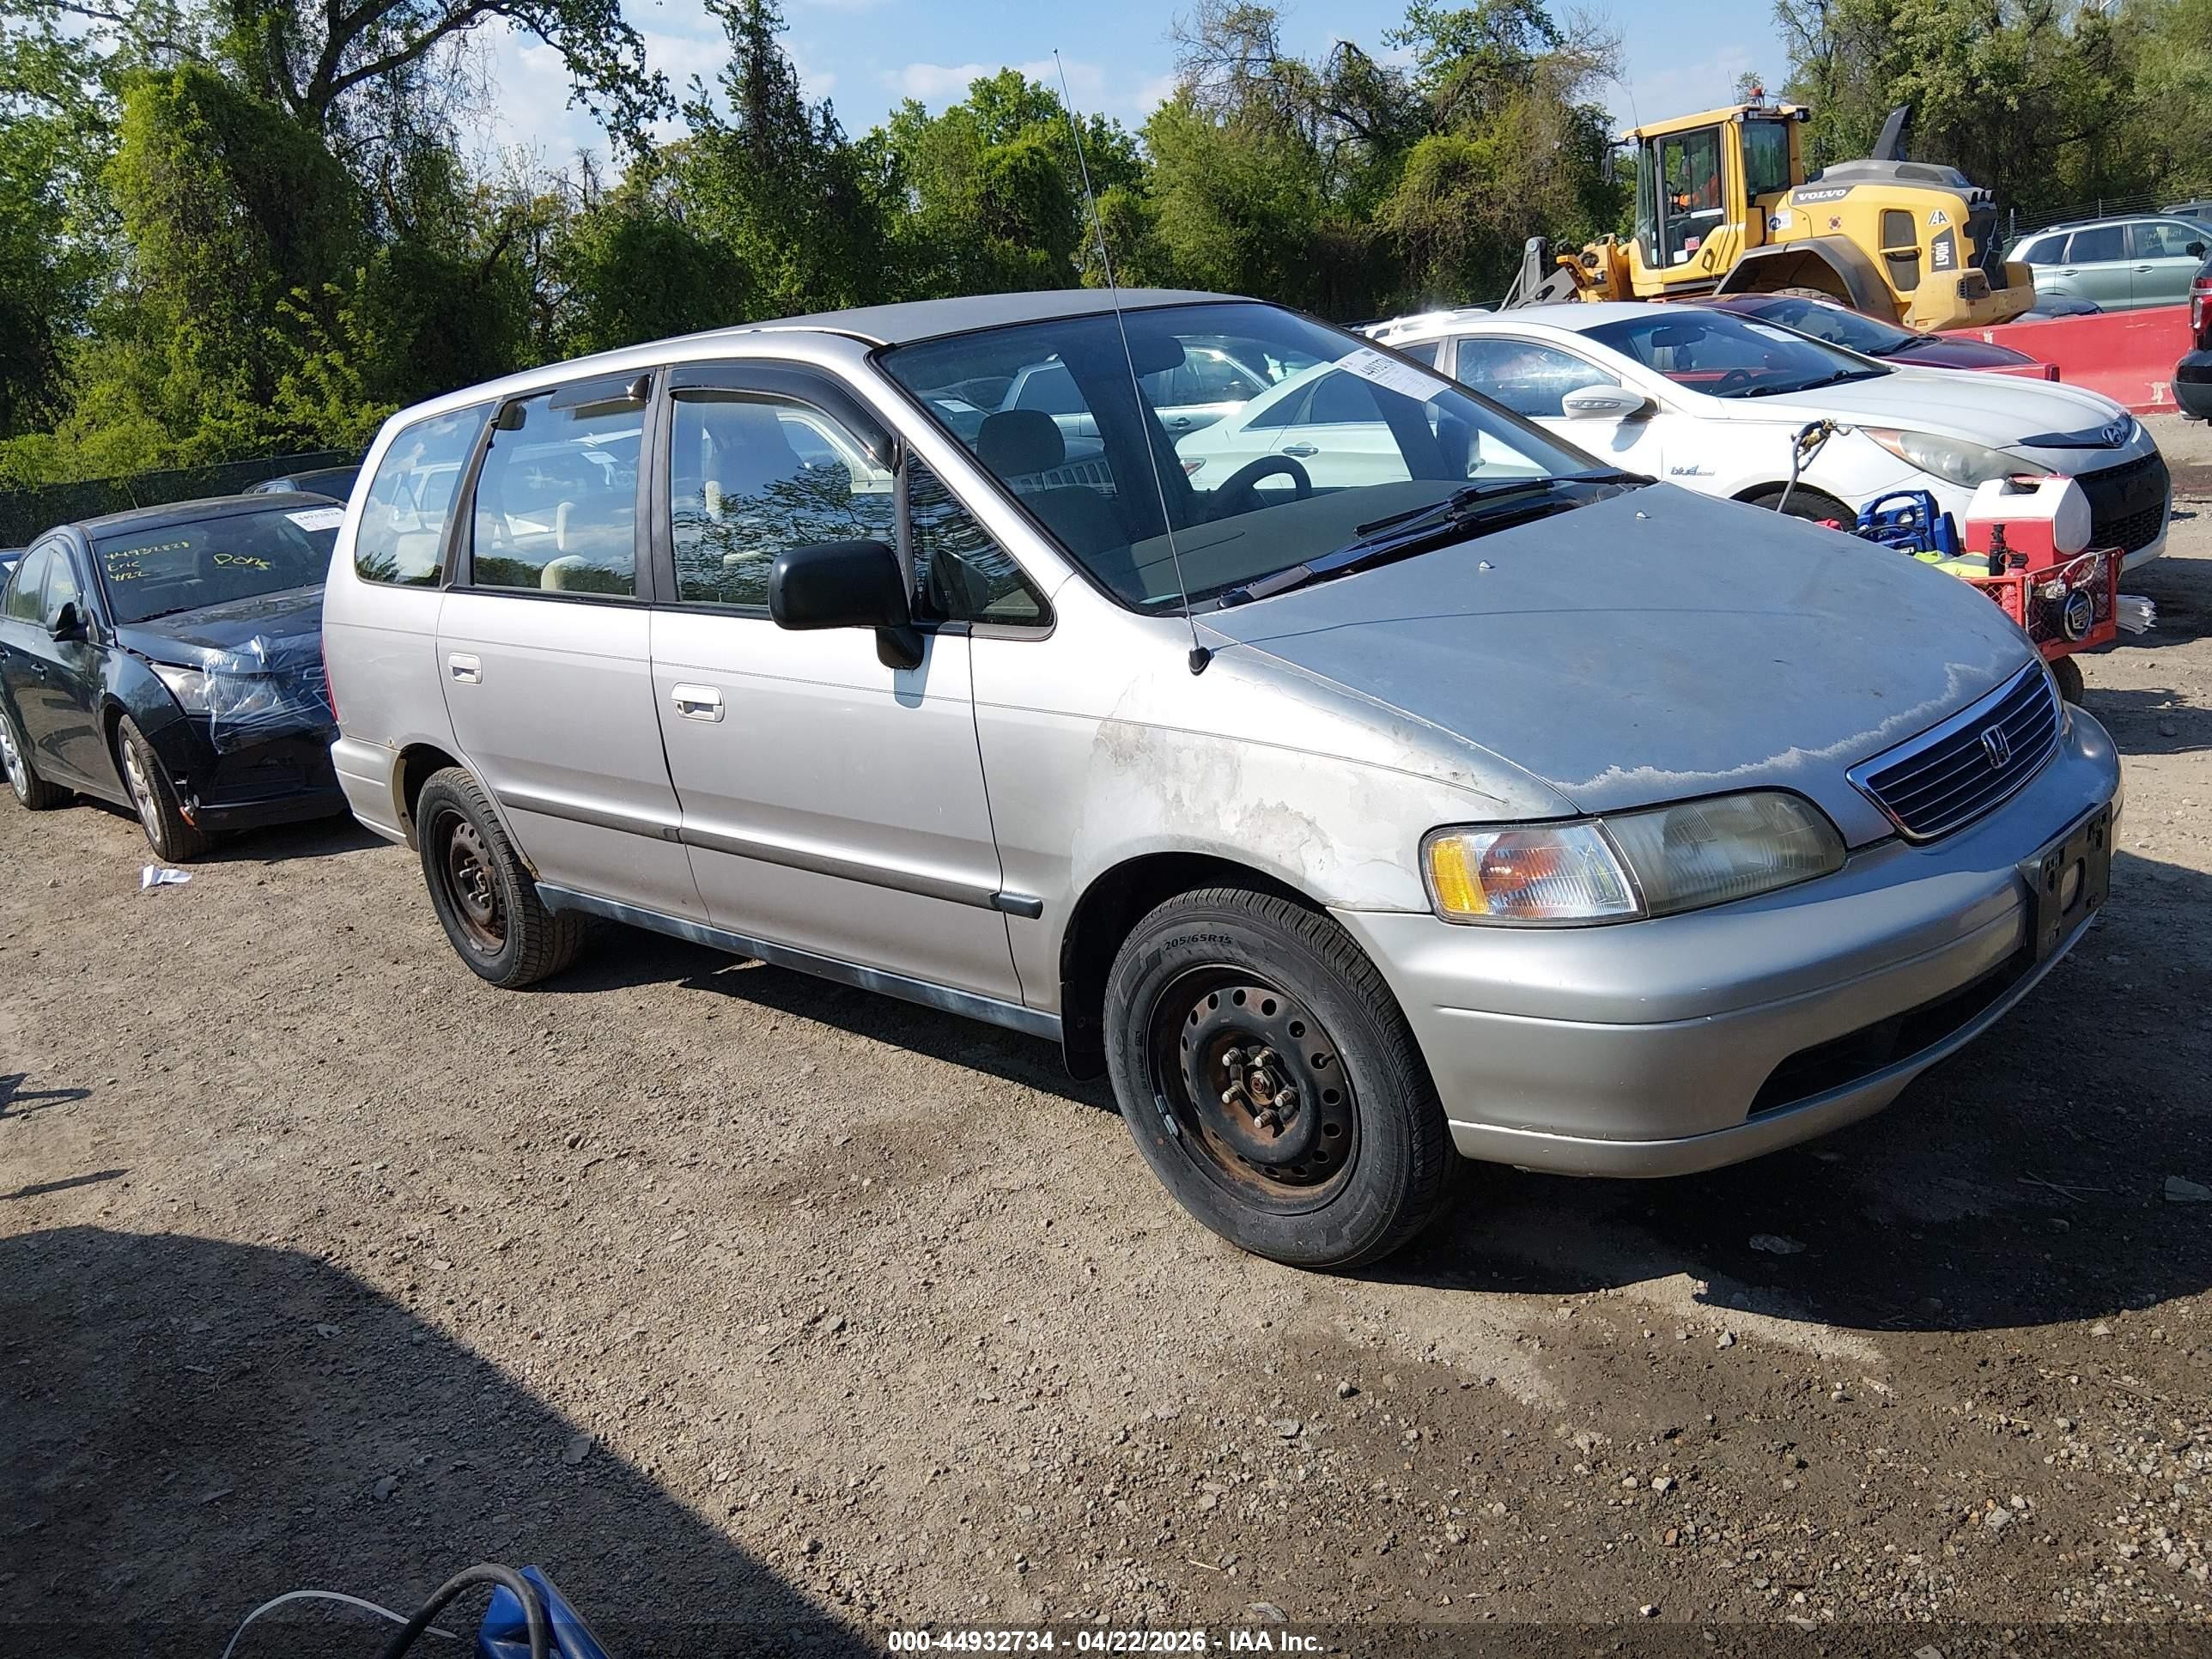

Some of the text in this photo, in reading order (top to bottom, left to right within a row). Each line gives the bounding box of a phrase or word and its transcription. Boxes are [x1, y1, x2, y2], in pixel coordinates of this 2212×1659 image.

[1797, 189, 1846, 201] VOLVO
[1935, 241, 1949, 266] L90H
[107, 561, 141, 572] Eric
[1164, 933, 1233, 951] 205/65R15
